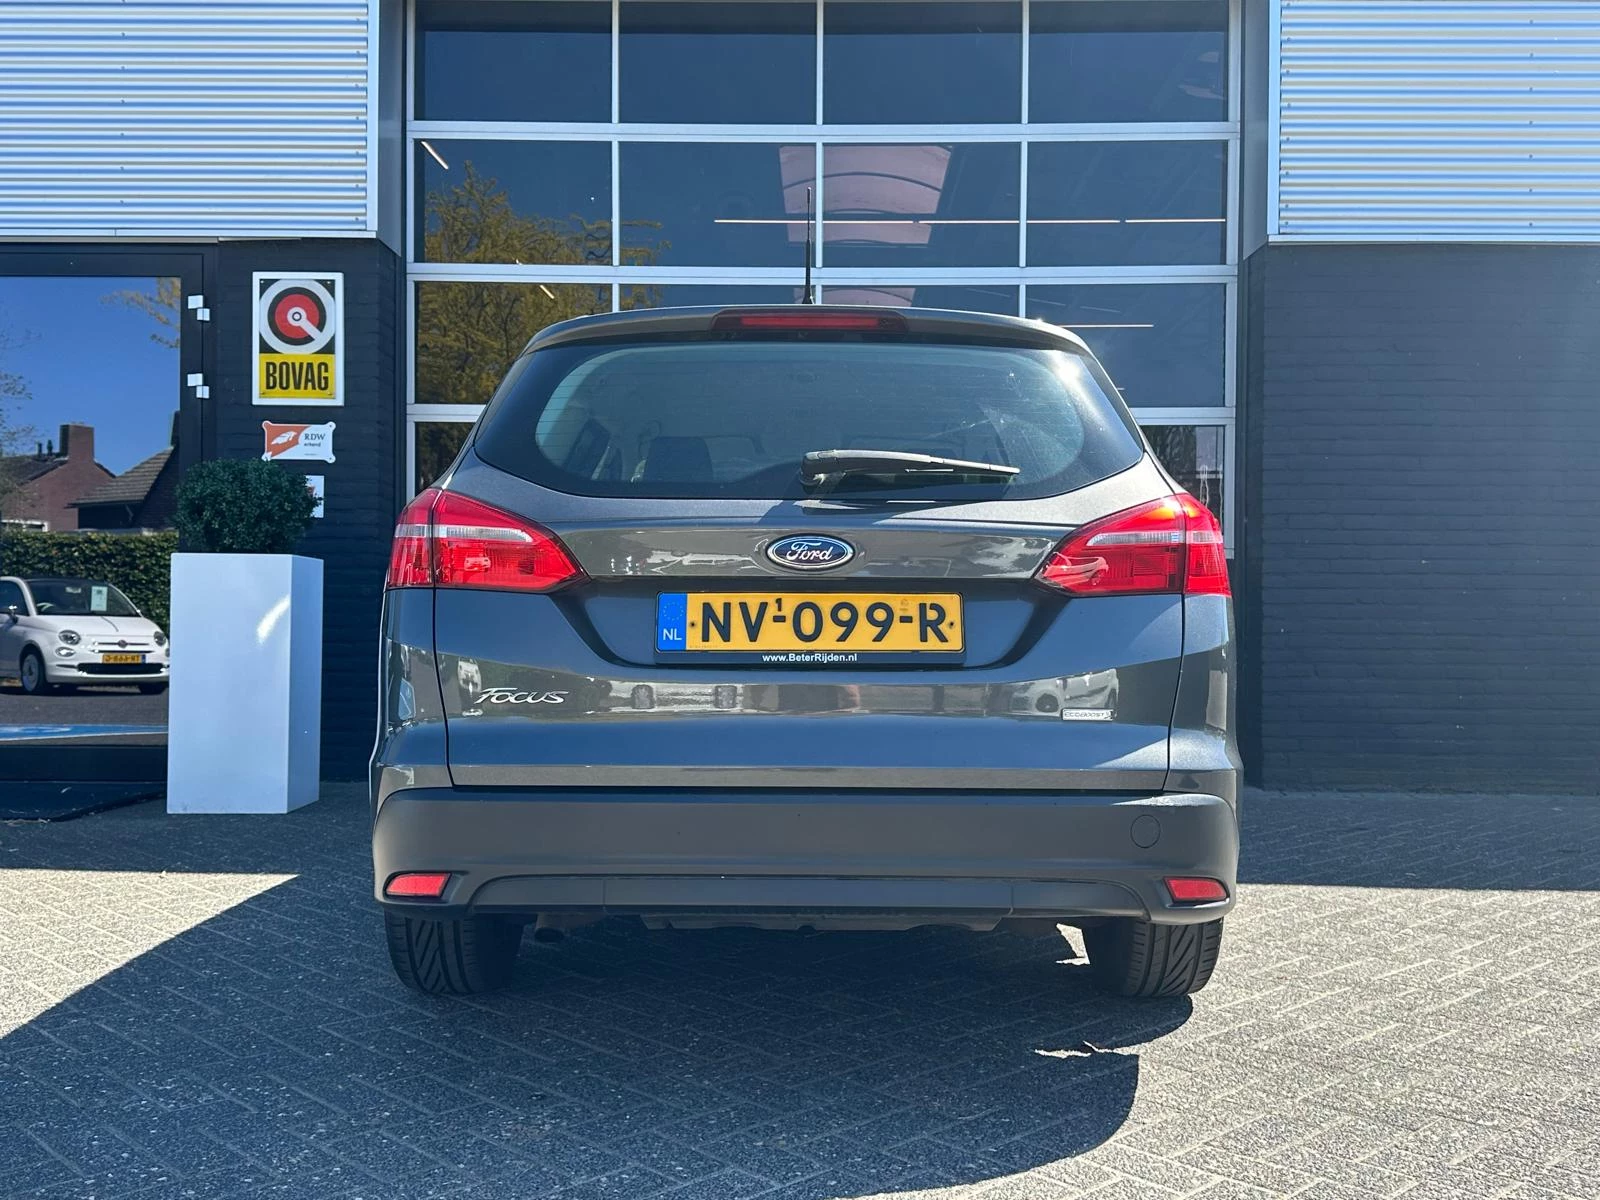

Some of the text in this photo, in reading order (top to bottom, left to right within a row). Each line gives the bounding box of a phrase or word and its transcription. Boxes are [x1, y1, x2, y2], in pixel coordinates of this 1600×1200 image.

[265, 361, 329, 391] BOVAG
[304, 433, 326, 441] RDW
[786, 541, 834, 561] Ford
[662, 628, 683, 642] NL
[762, 653, 858, 664] www.BeterRijden.nl
